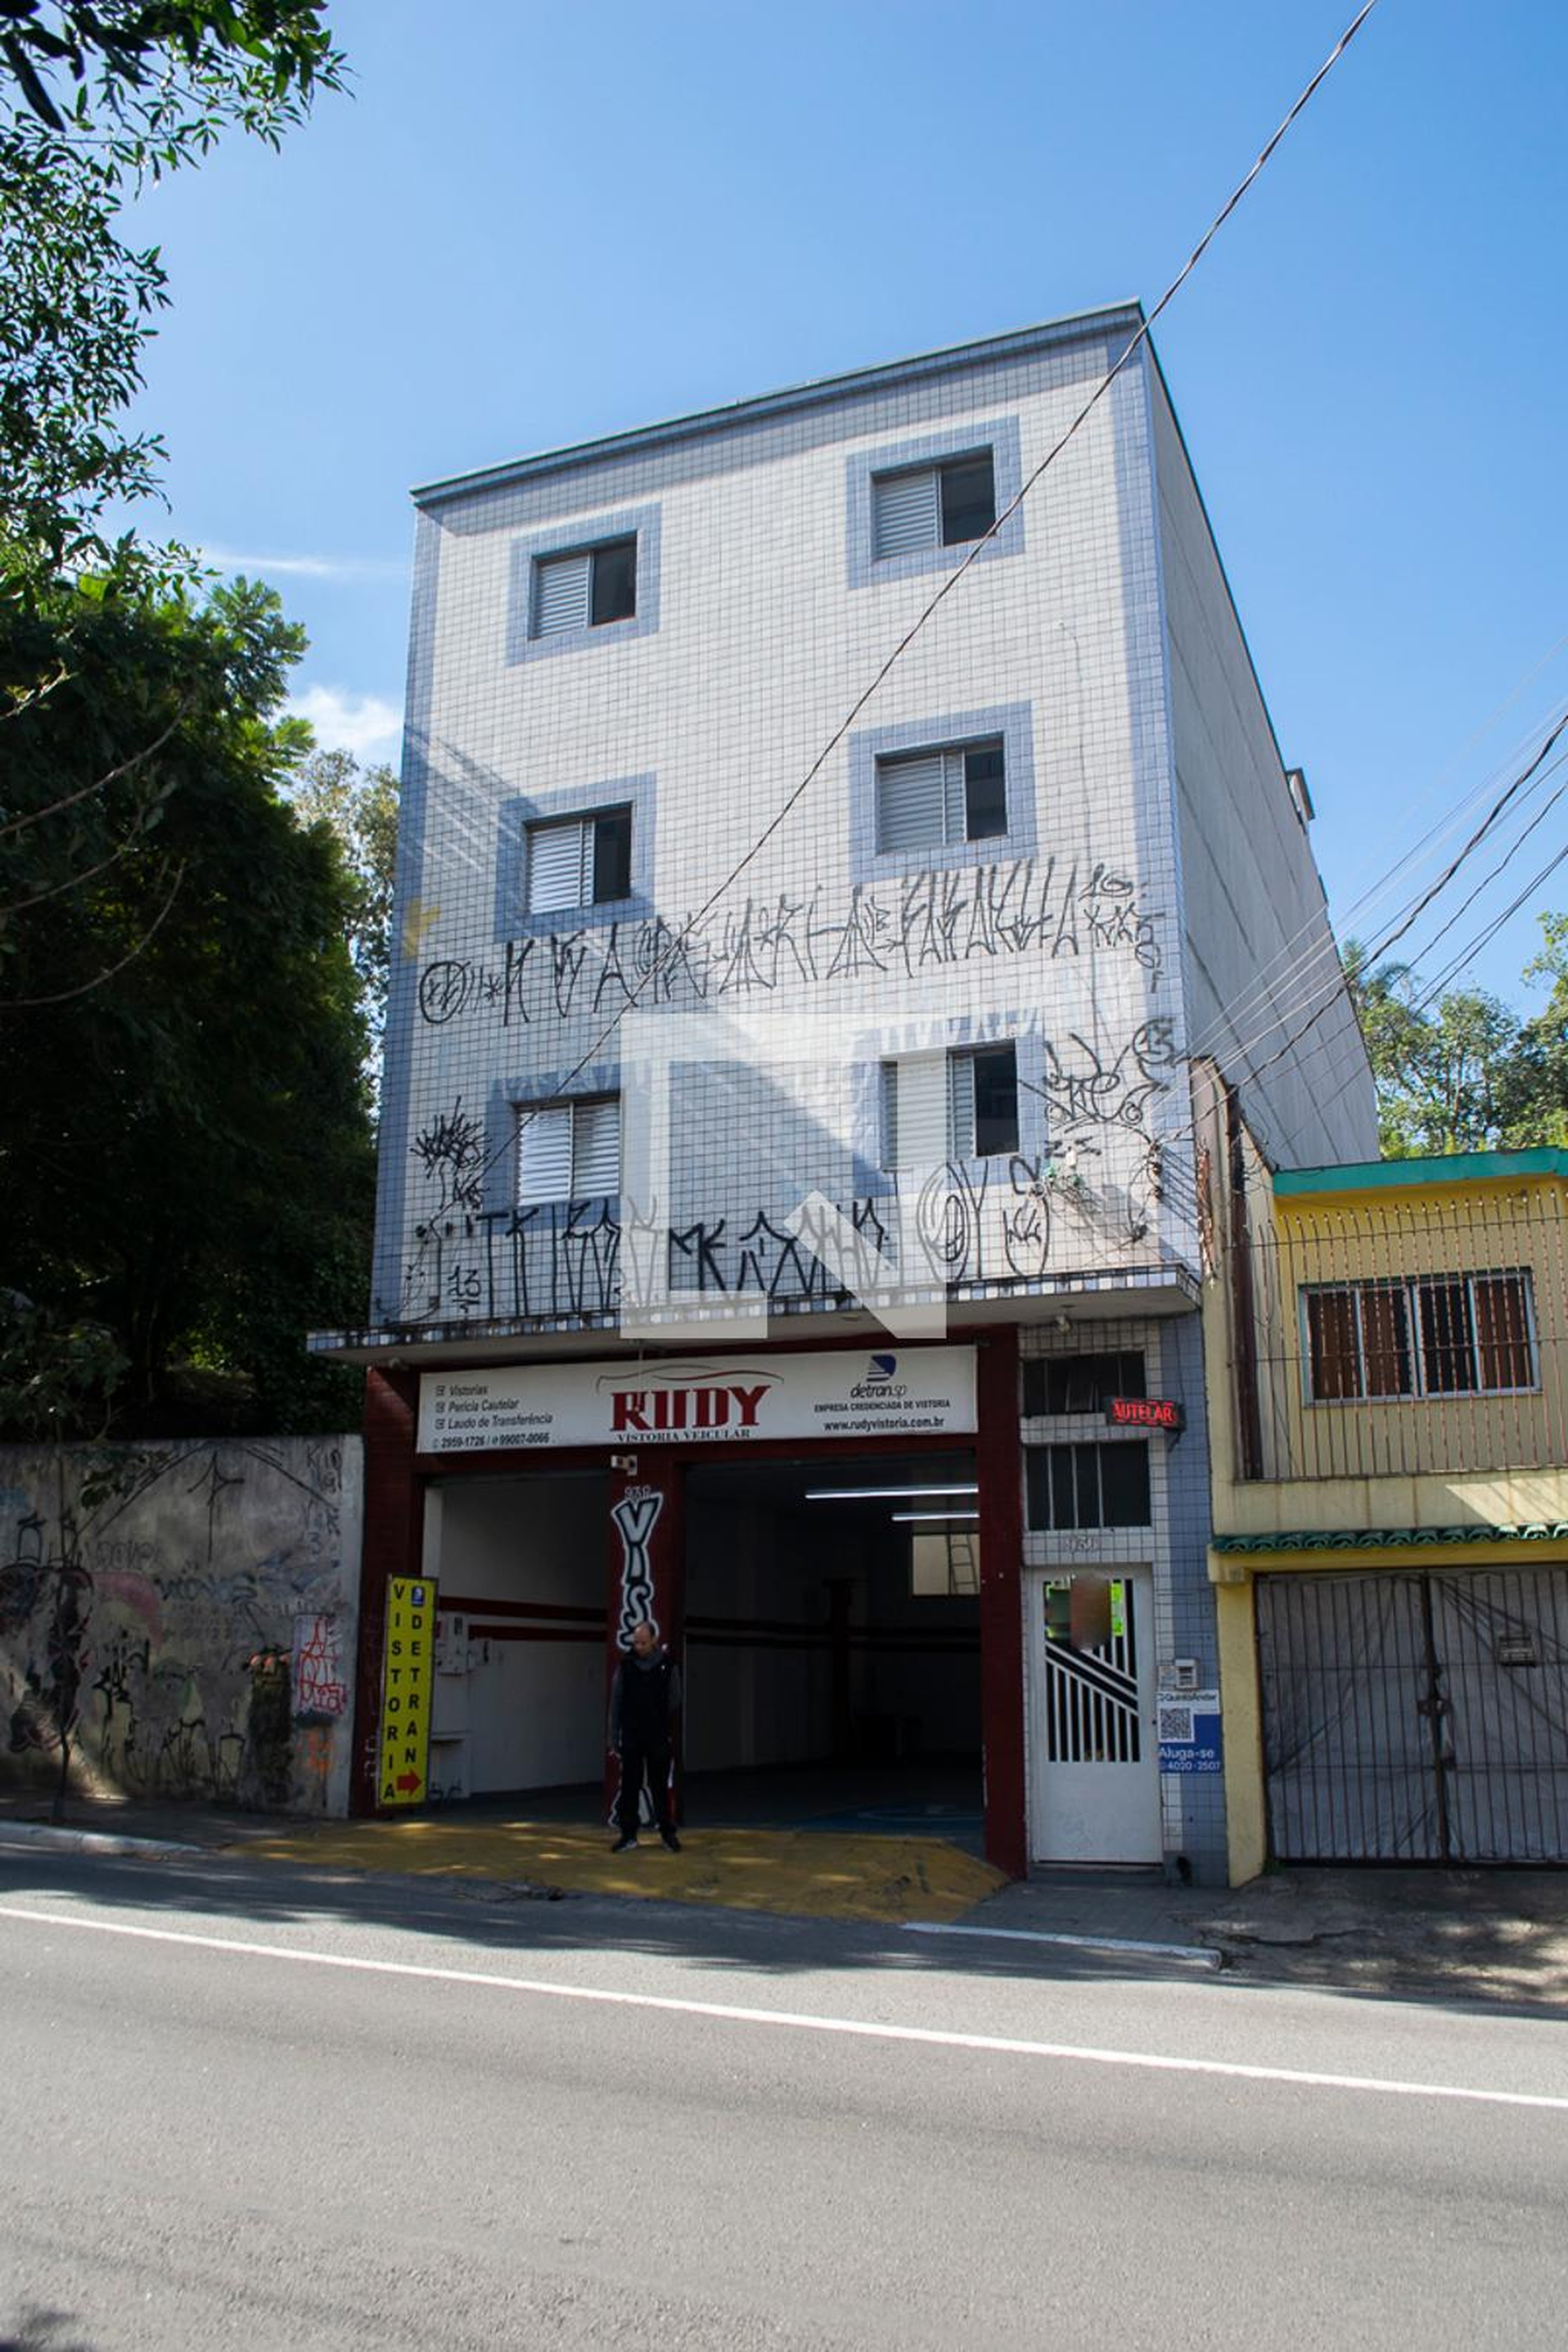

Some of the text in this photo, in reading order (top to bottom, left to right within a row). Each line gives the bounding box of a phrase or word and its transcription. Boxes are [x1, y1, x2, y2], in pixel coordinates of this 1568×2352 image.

[610, 1385, 772, 1432] RUDY
[814, 1399, 950, 1413] EMPRESA CREDENCIADA DE VISTORIA
[448, 1418, 476, 1430] Laudo
[478, 1416, 490, 1428] de
[823, 1416, 944, 1432] www.rudyvistoria.com.br
[683, 1429, 751, 1441] VEICULAR
[384, 1584, 405, 1799] VISTORIA
[405, 1615, 423, 1764] DETRAN
[1159, 1746, 1214, 1761] Aluga-se
